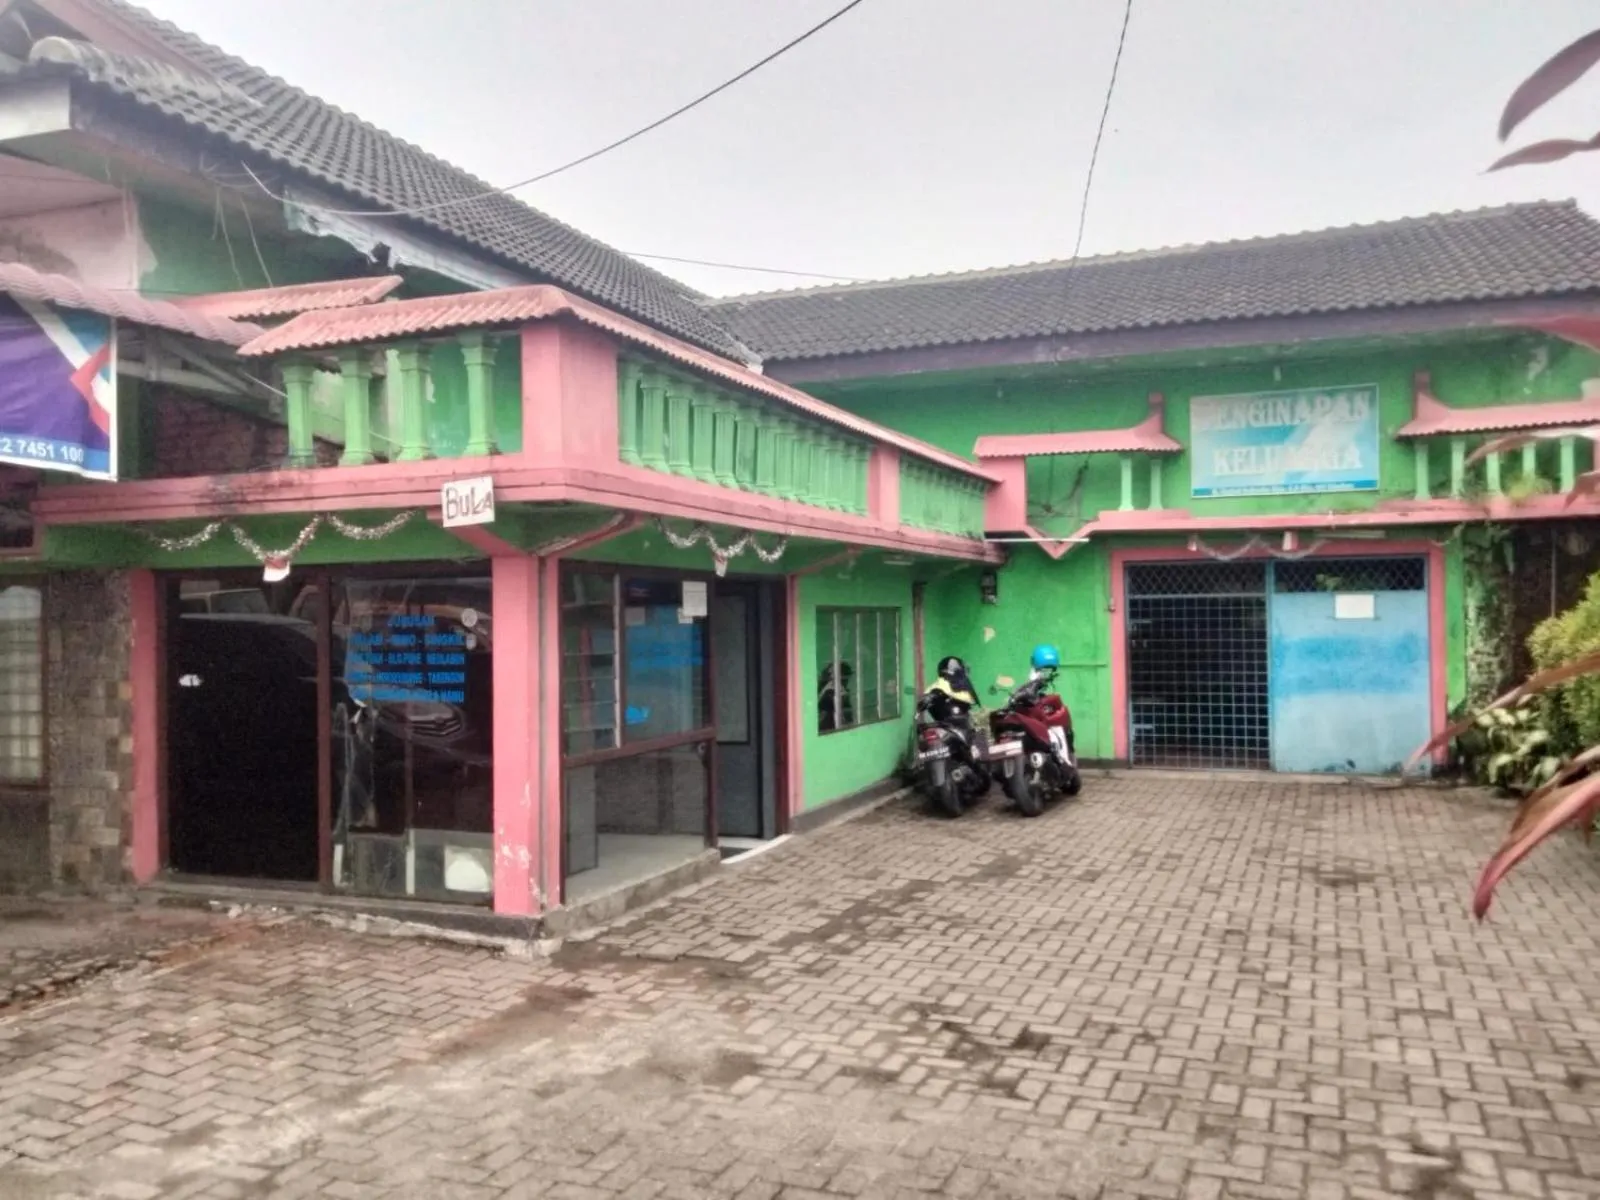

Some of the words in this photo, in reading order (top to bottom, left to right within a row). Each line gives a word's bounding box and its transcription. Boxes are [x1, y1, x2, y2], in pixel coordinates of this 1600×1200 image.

[1193, 391, 1371, 430] ENGINAPAN
[0, 436, 13, 454] 2
[16, 439, 55, 459] 7451
